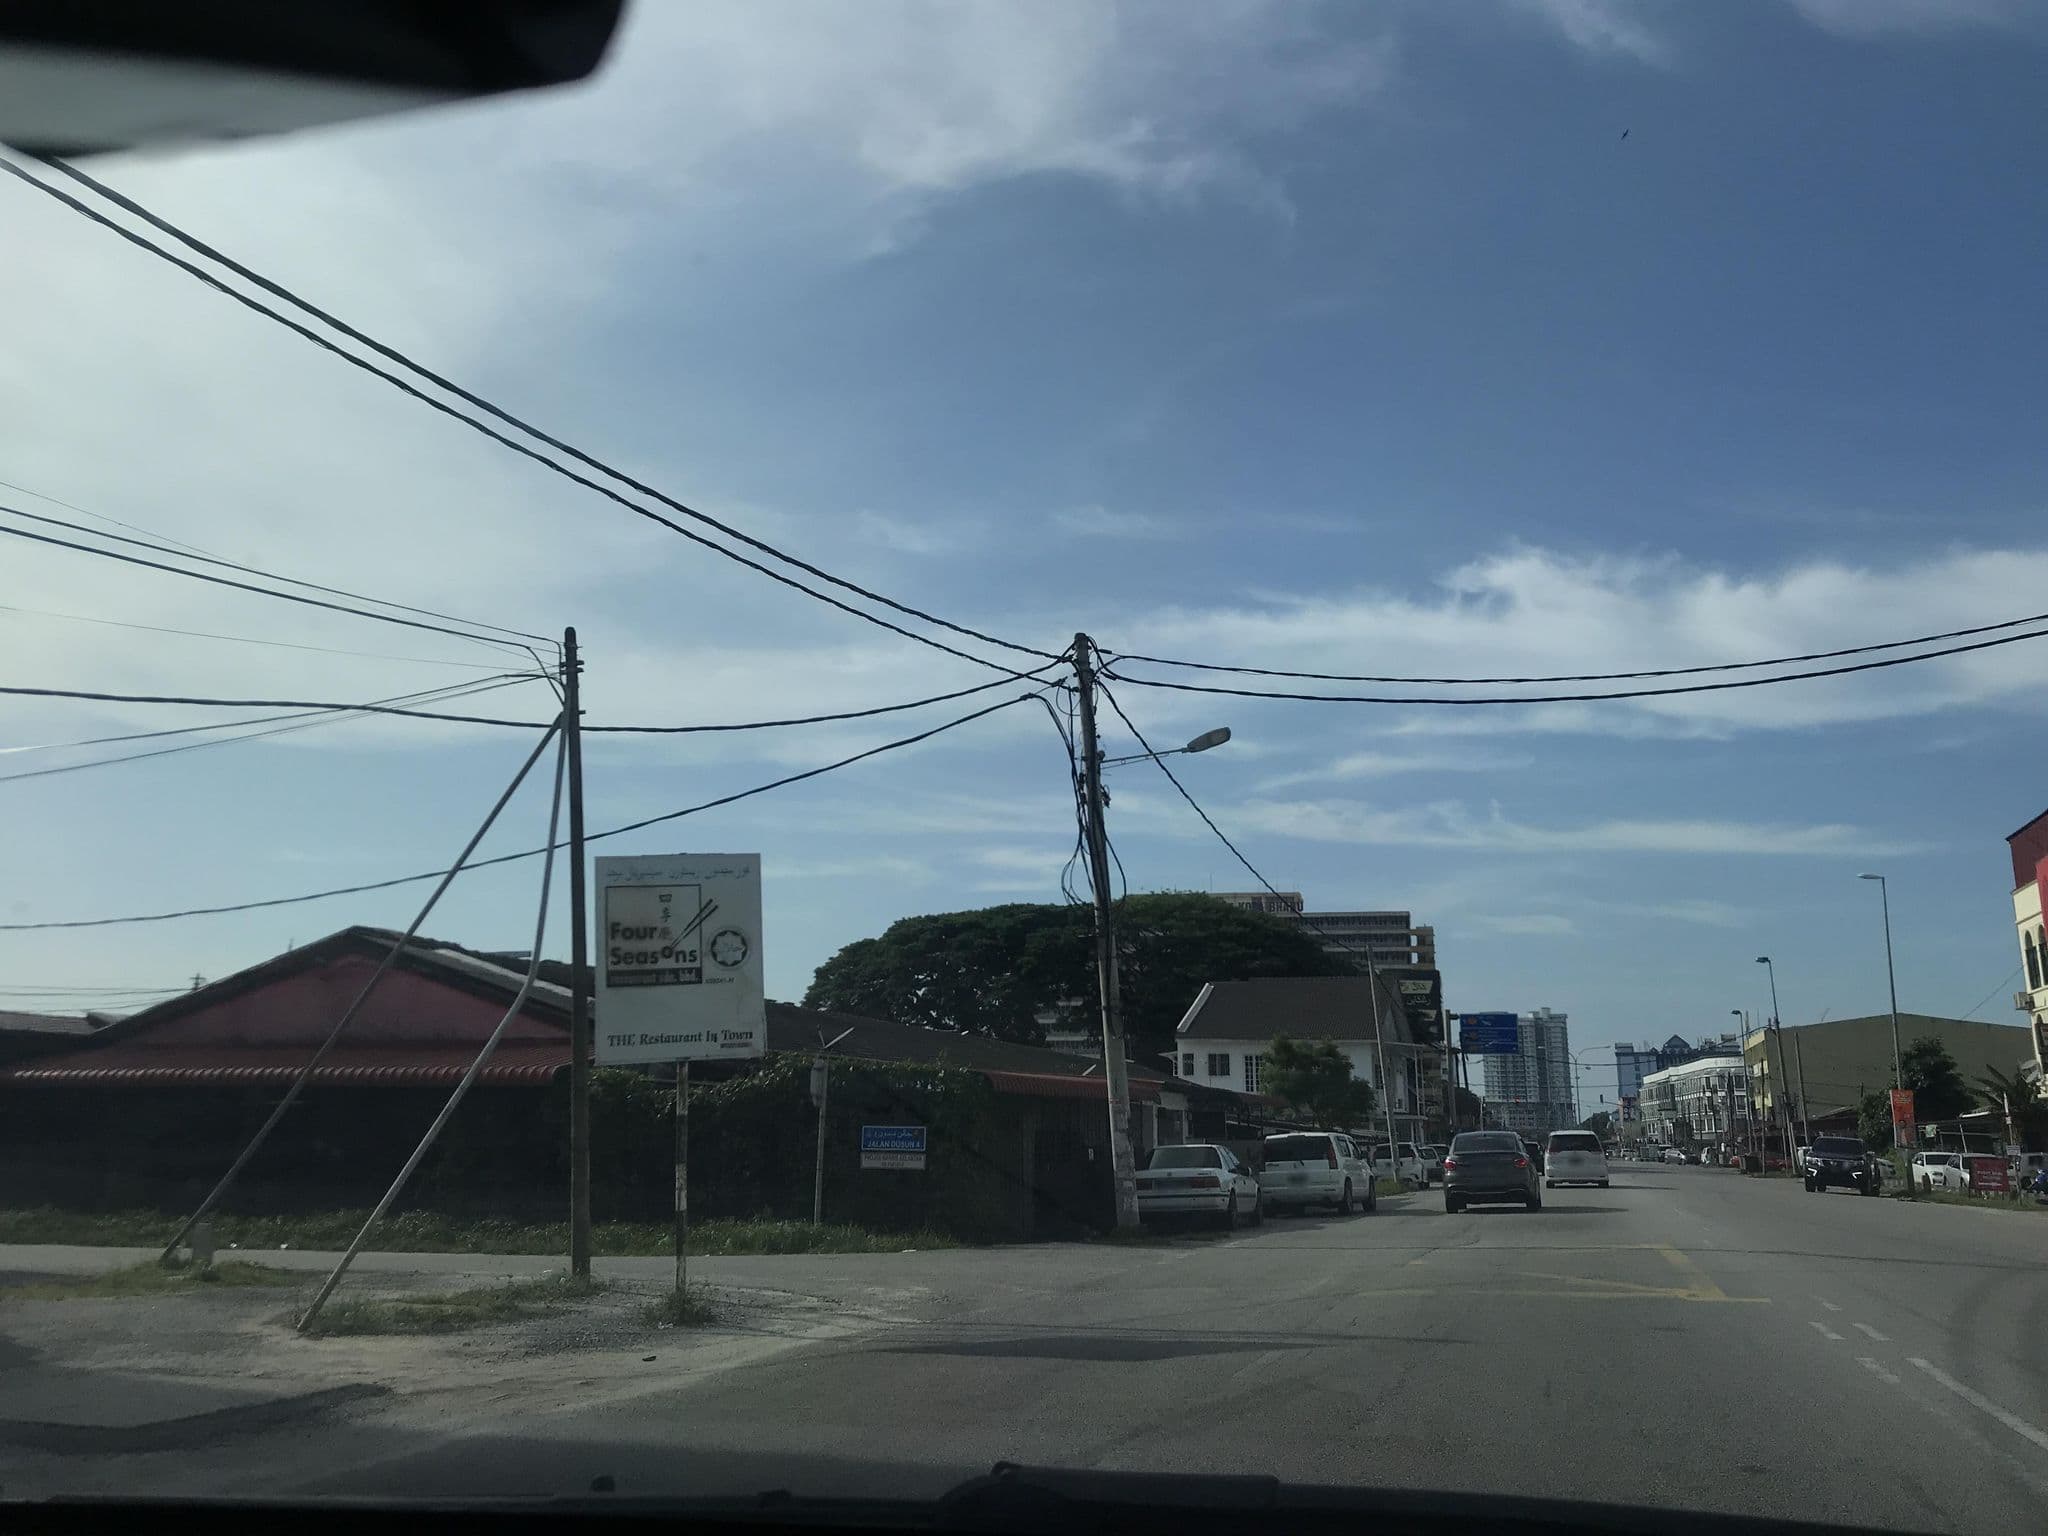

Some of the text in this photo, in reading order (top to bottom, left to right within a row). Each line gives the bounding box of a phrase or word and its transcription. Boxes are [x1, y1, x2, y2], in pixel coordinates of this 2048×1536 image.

[610, 922, 657, 940] Four
[610, 946, 698, 965] Seasons
[607, 1034, 636, 1047] THE
[639, 1031, 702, 1046] Restaurant
[720, 1029, 753, 1041] Town
